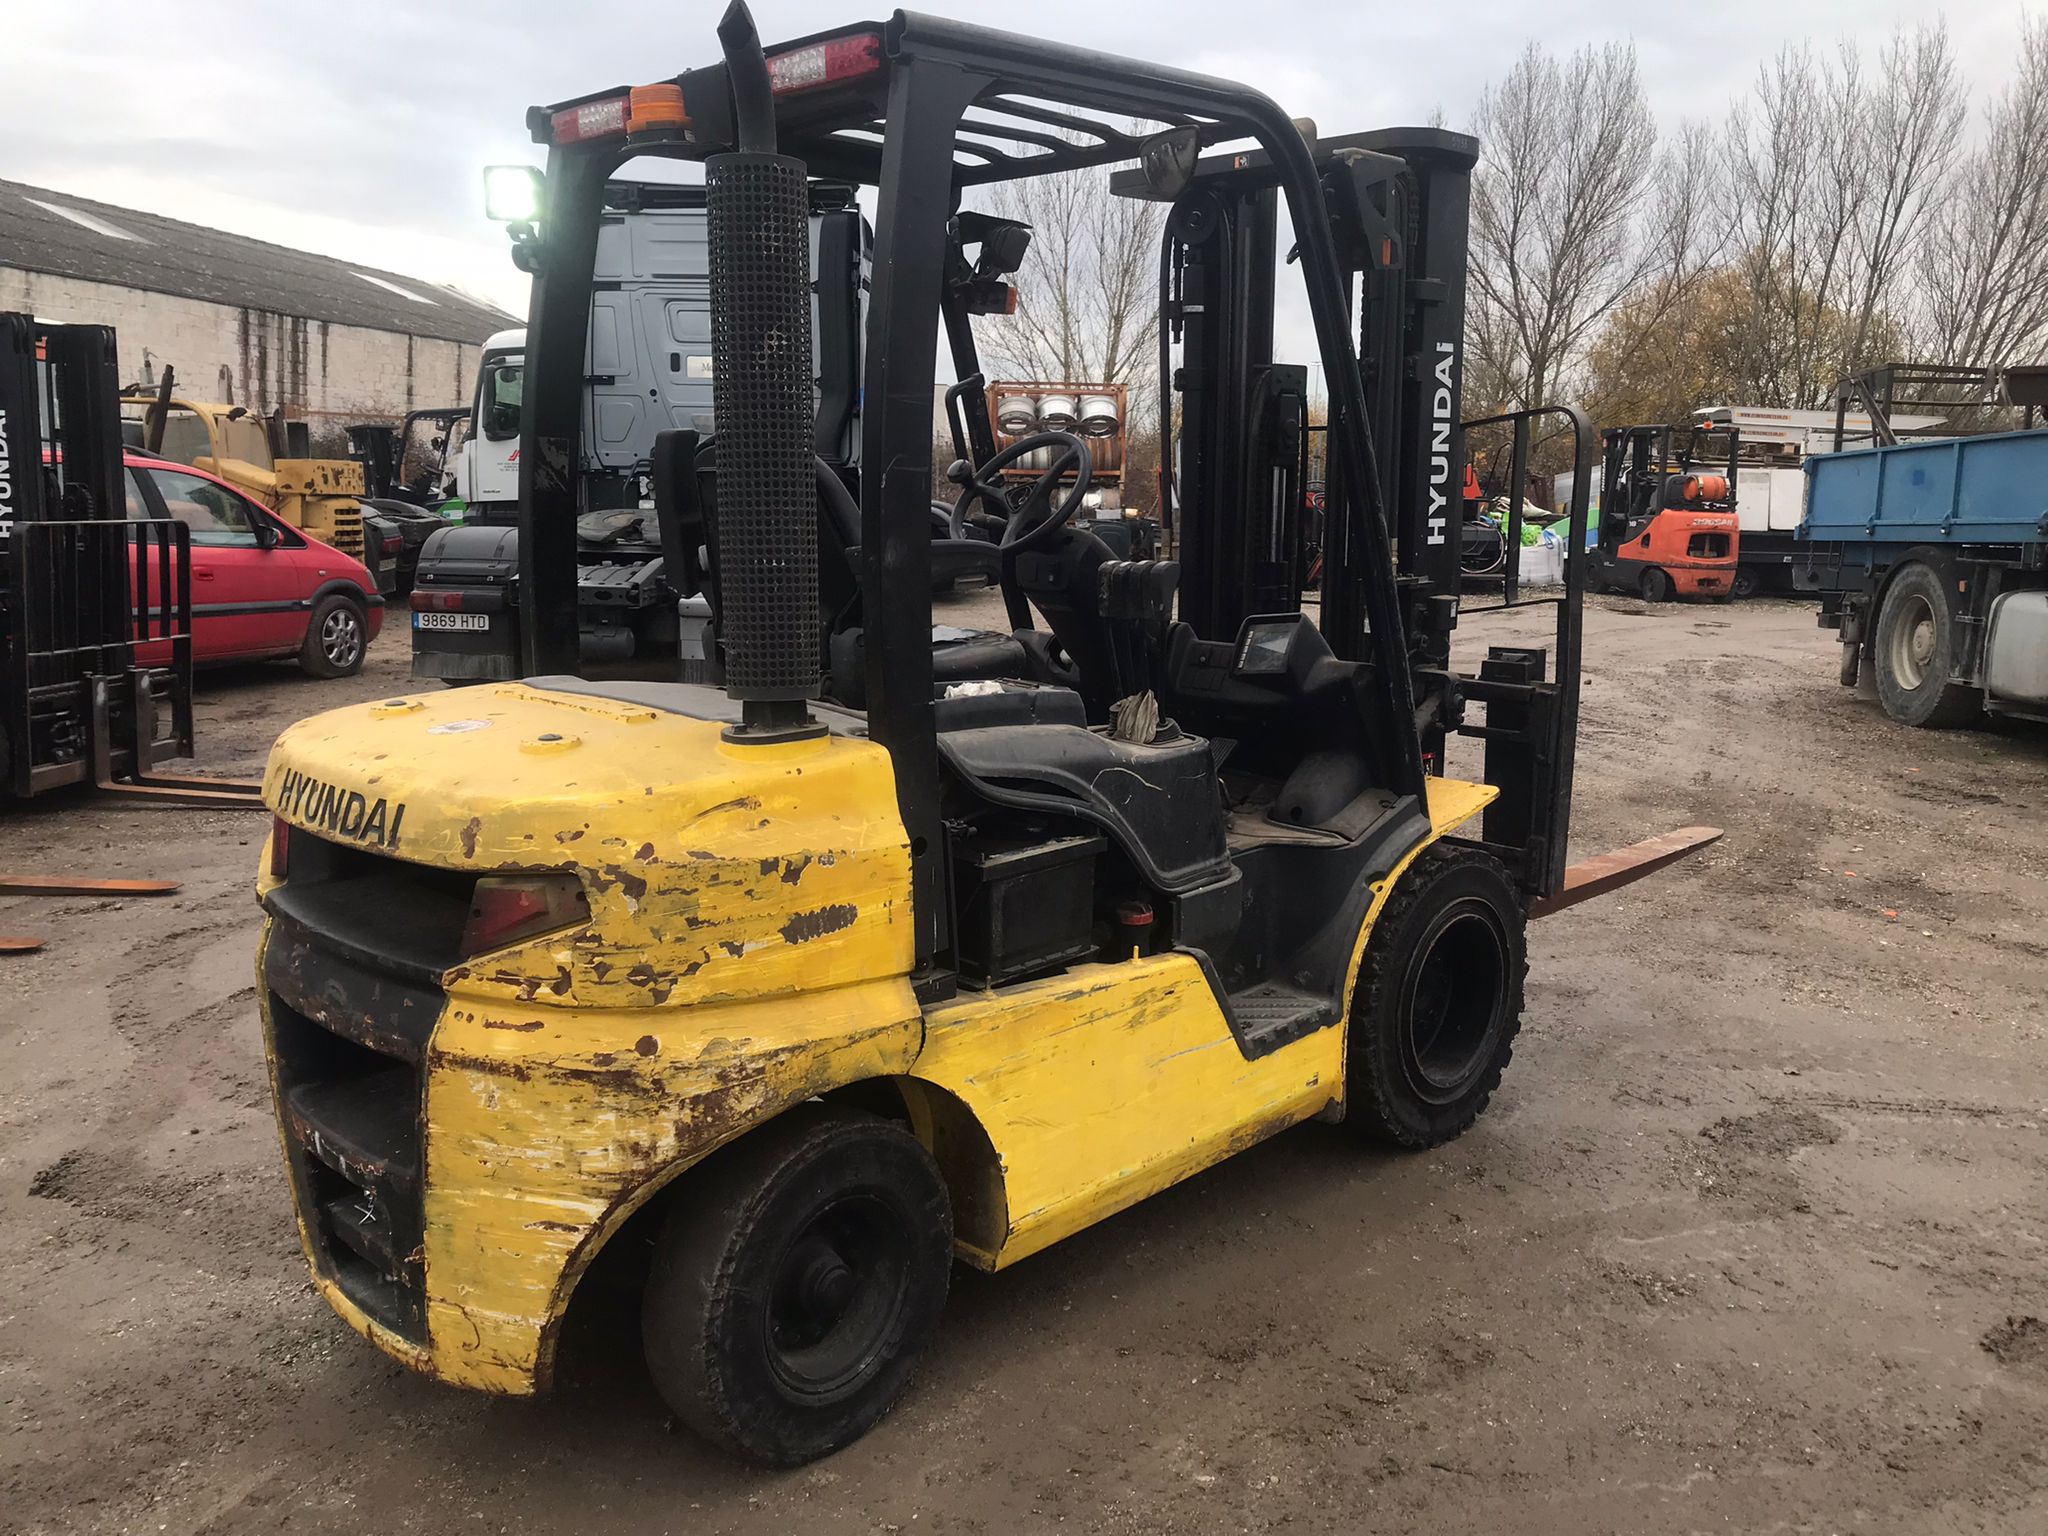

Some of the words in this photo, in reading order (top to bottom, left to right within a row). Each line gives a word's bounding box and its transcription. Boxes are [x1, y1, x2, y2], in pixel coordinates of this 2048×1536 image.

[1427, 342, 1454, 545] HYUNDAI
[422, 614, 456, 627] 9869
[461, 615, 486, 629] HTD
[278, 767, 406, 848] HYUNDAI
